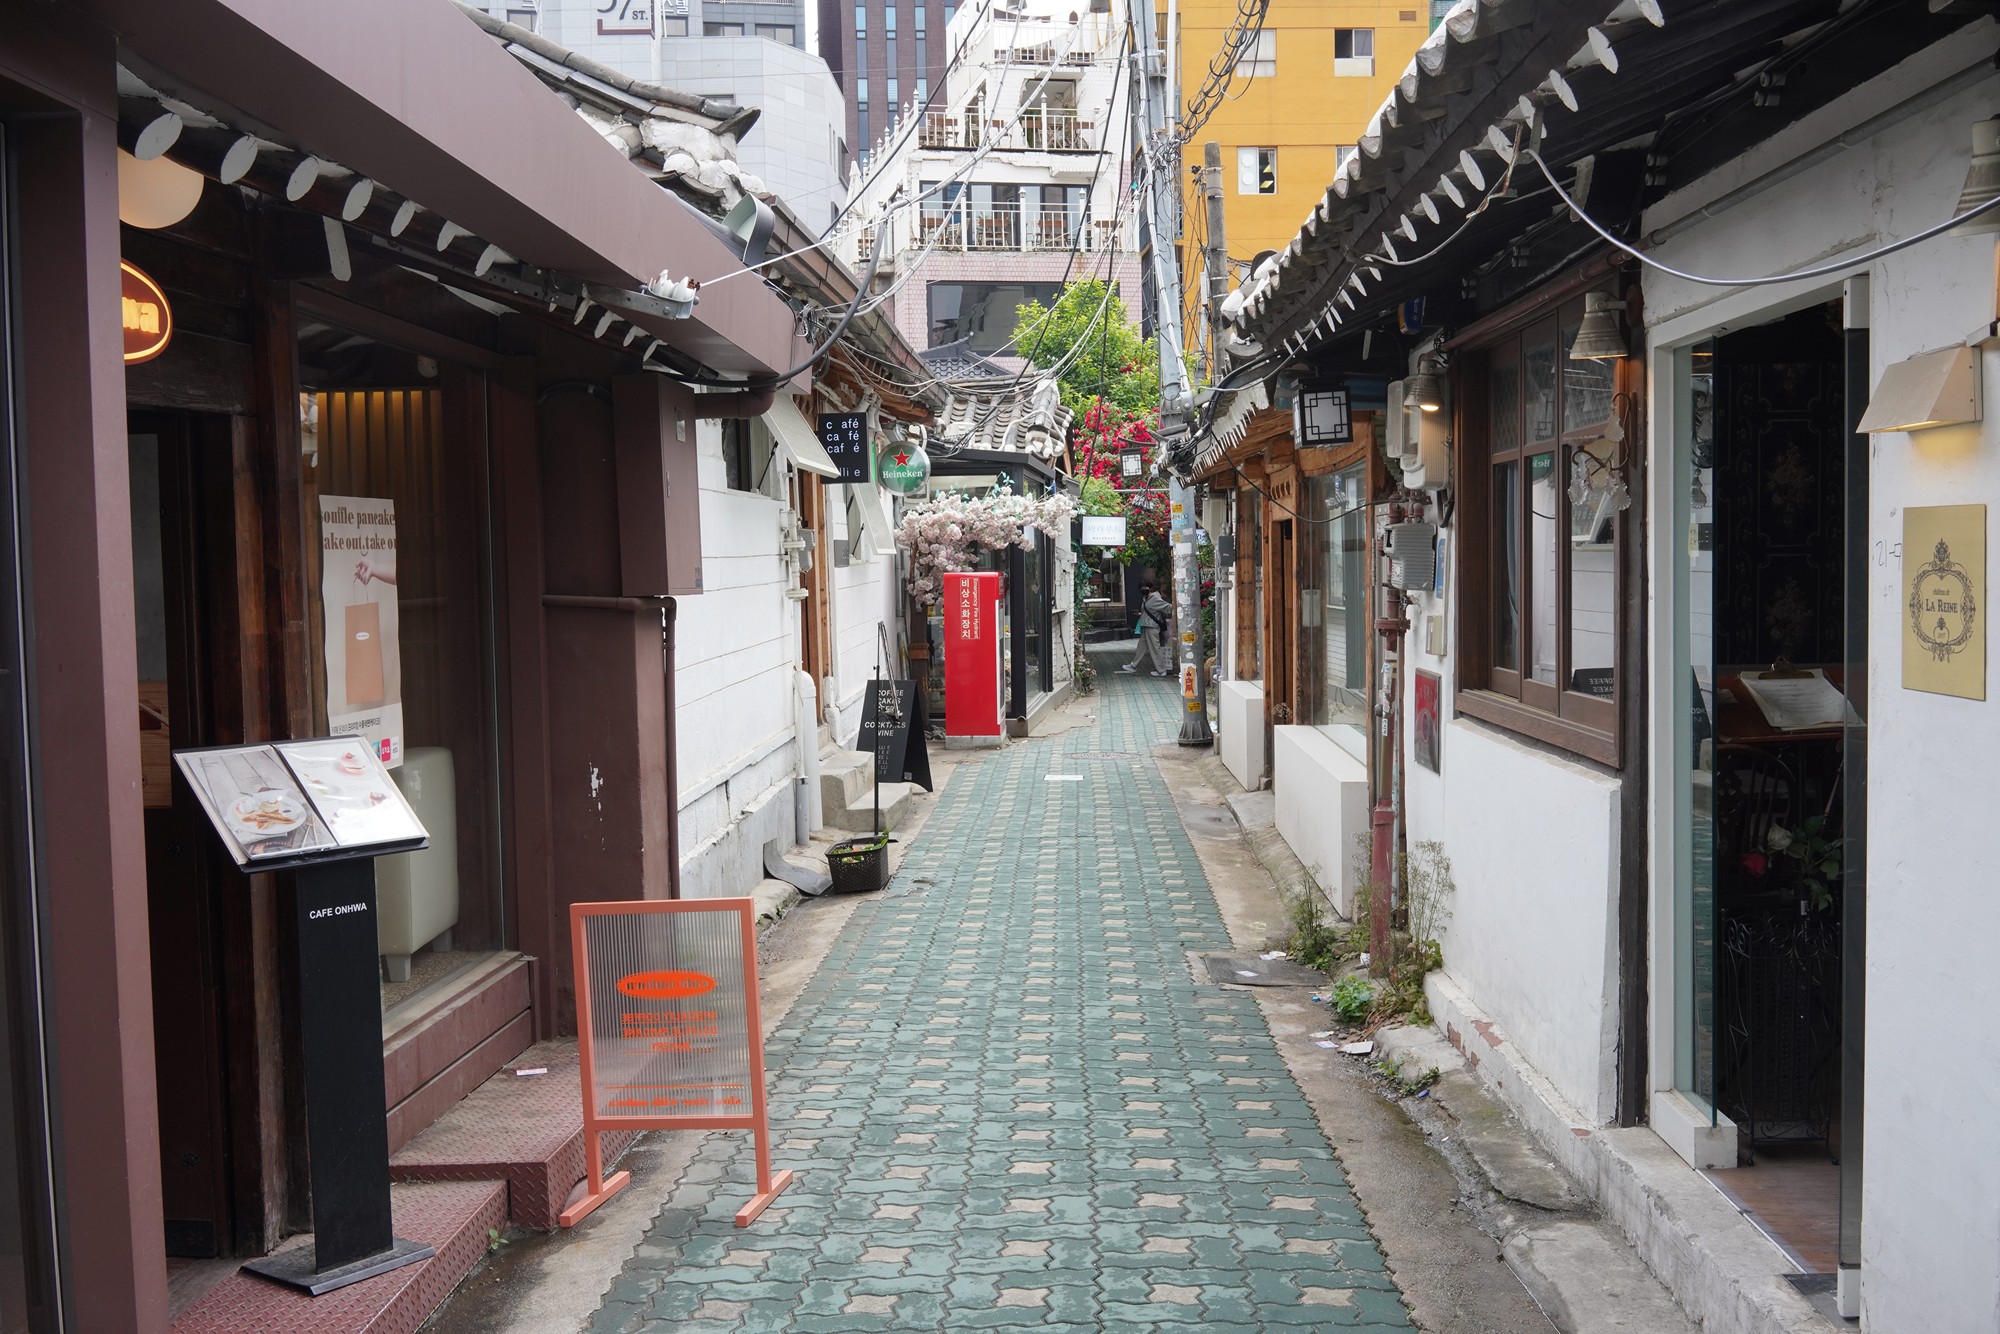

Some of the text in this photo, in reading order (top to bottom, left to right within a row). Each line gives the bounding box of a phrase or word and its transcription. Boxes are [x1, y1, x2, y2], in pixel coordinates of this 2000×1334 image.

[631, 10, 648, 20] ST.
[841, 418, 859, 429] afé
[882, 470, 923, 478] Heineken
[323, 532, 344, 550] ake
[961, 578, 970, 639] 비상소화장치
[1926, 598, 1958, 613] LA REINE
[309, 902, 367, 919] CAFE ONHWA
